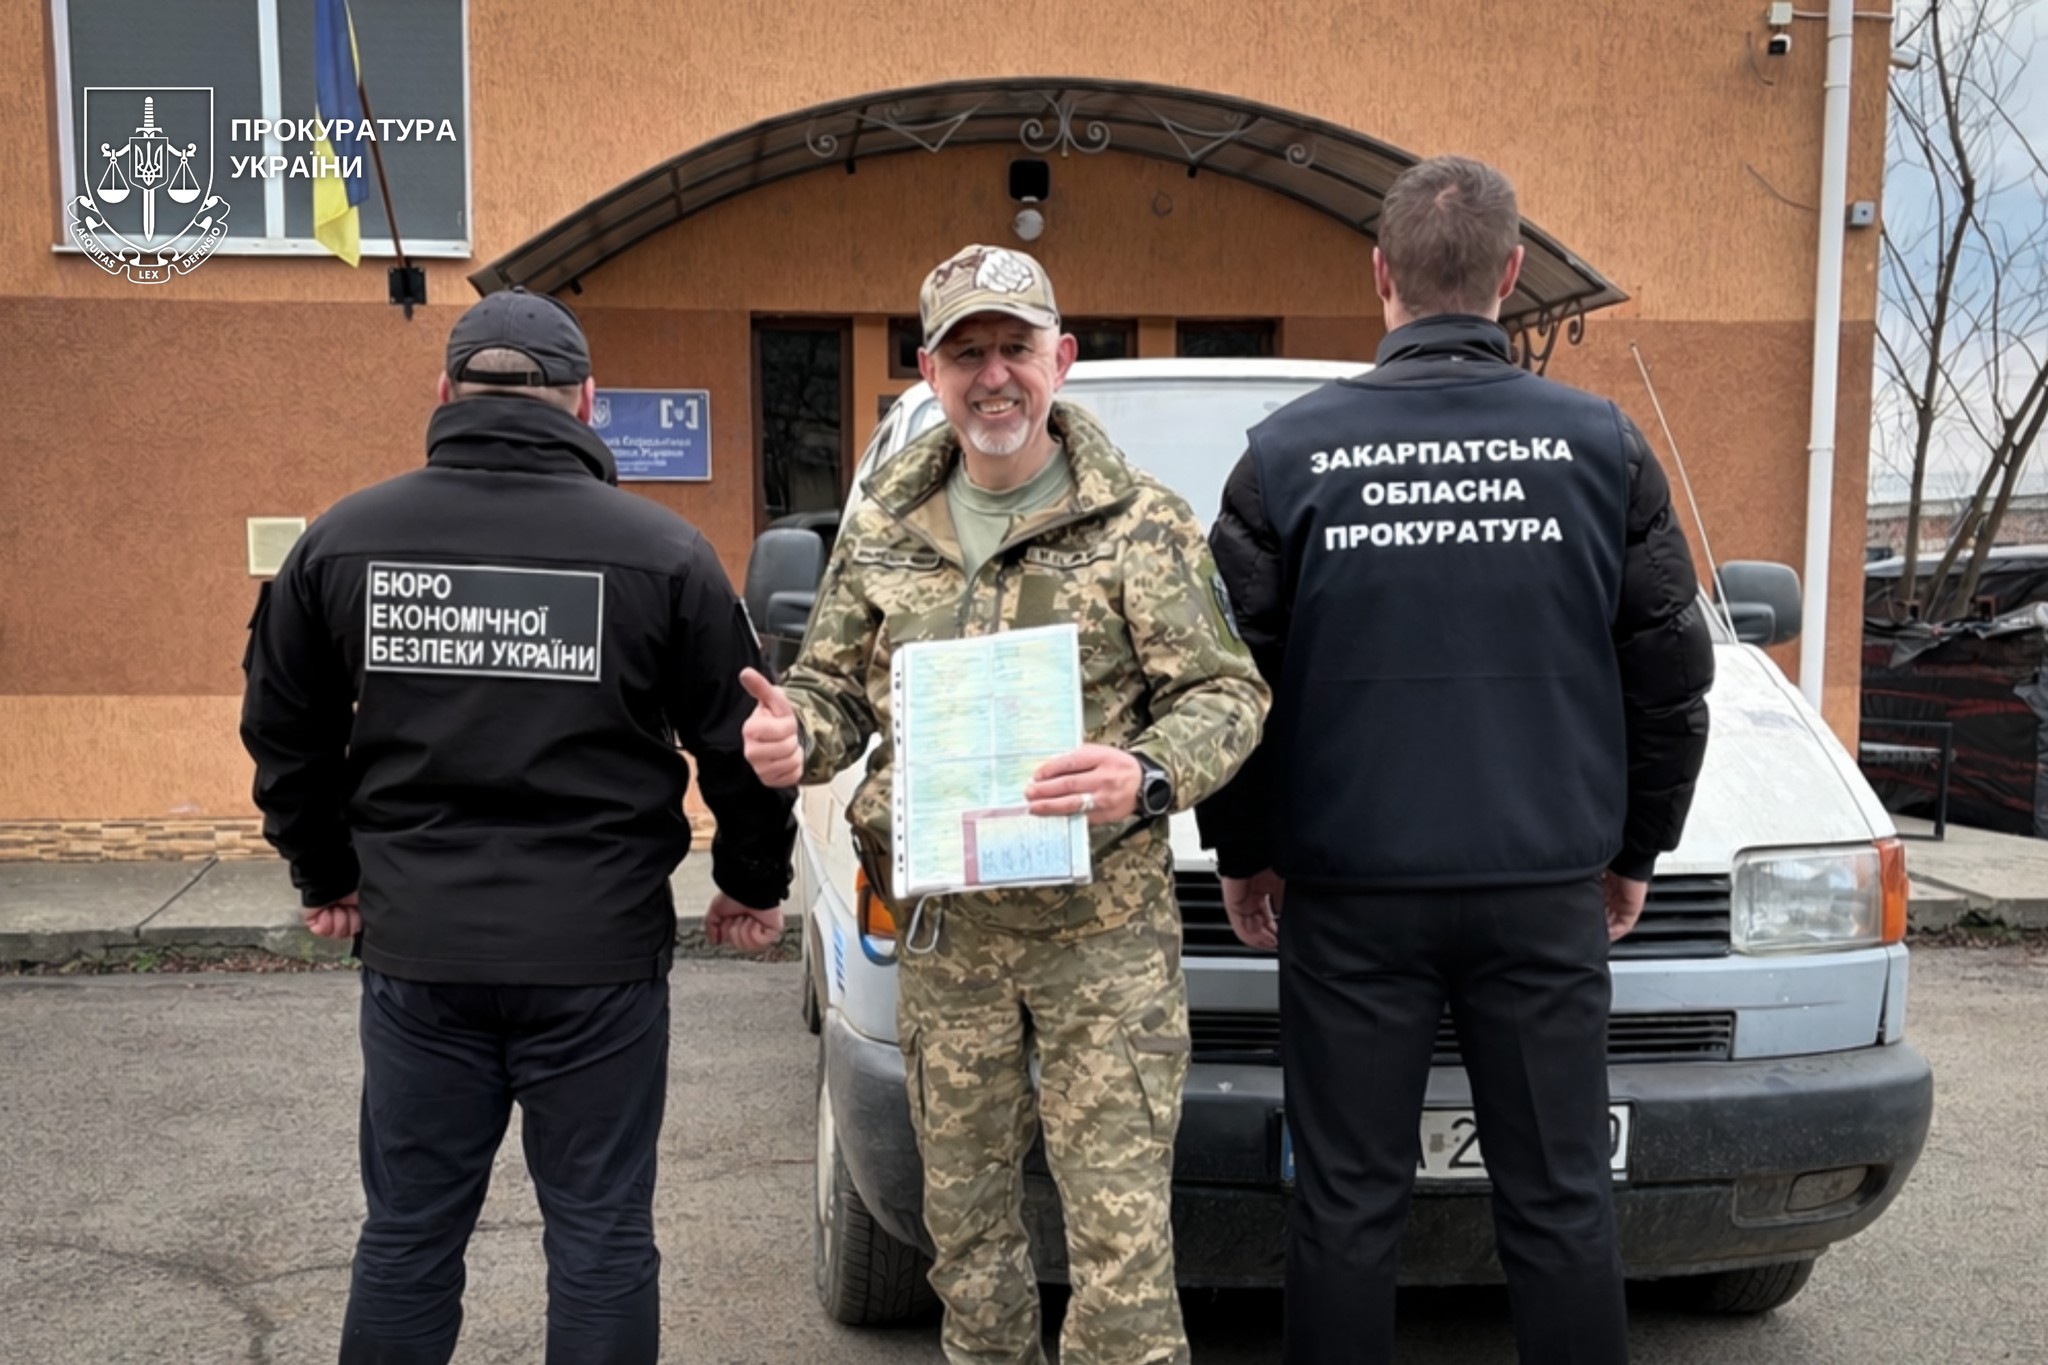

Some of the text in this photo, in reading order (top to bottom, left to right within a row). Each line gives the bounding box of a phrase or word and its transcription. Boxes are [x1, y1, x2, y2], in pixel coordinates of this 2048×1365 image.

[1310, 437, 1574, 474] ЗАКАРПАТСЬКА
[1361, 478, 1526, 506] ОБЛАСНА
[1324, 517, 1563, 550] ПРОКУРАТУРА
[372, 570, 452, 599] БЮРО
[371, 603, 549, 636] ЕКОНОМІЧНОЇ
[371, 636, 596, 672] БЕЗПЕКИ УКРАЇНИ
